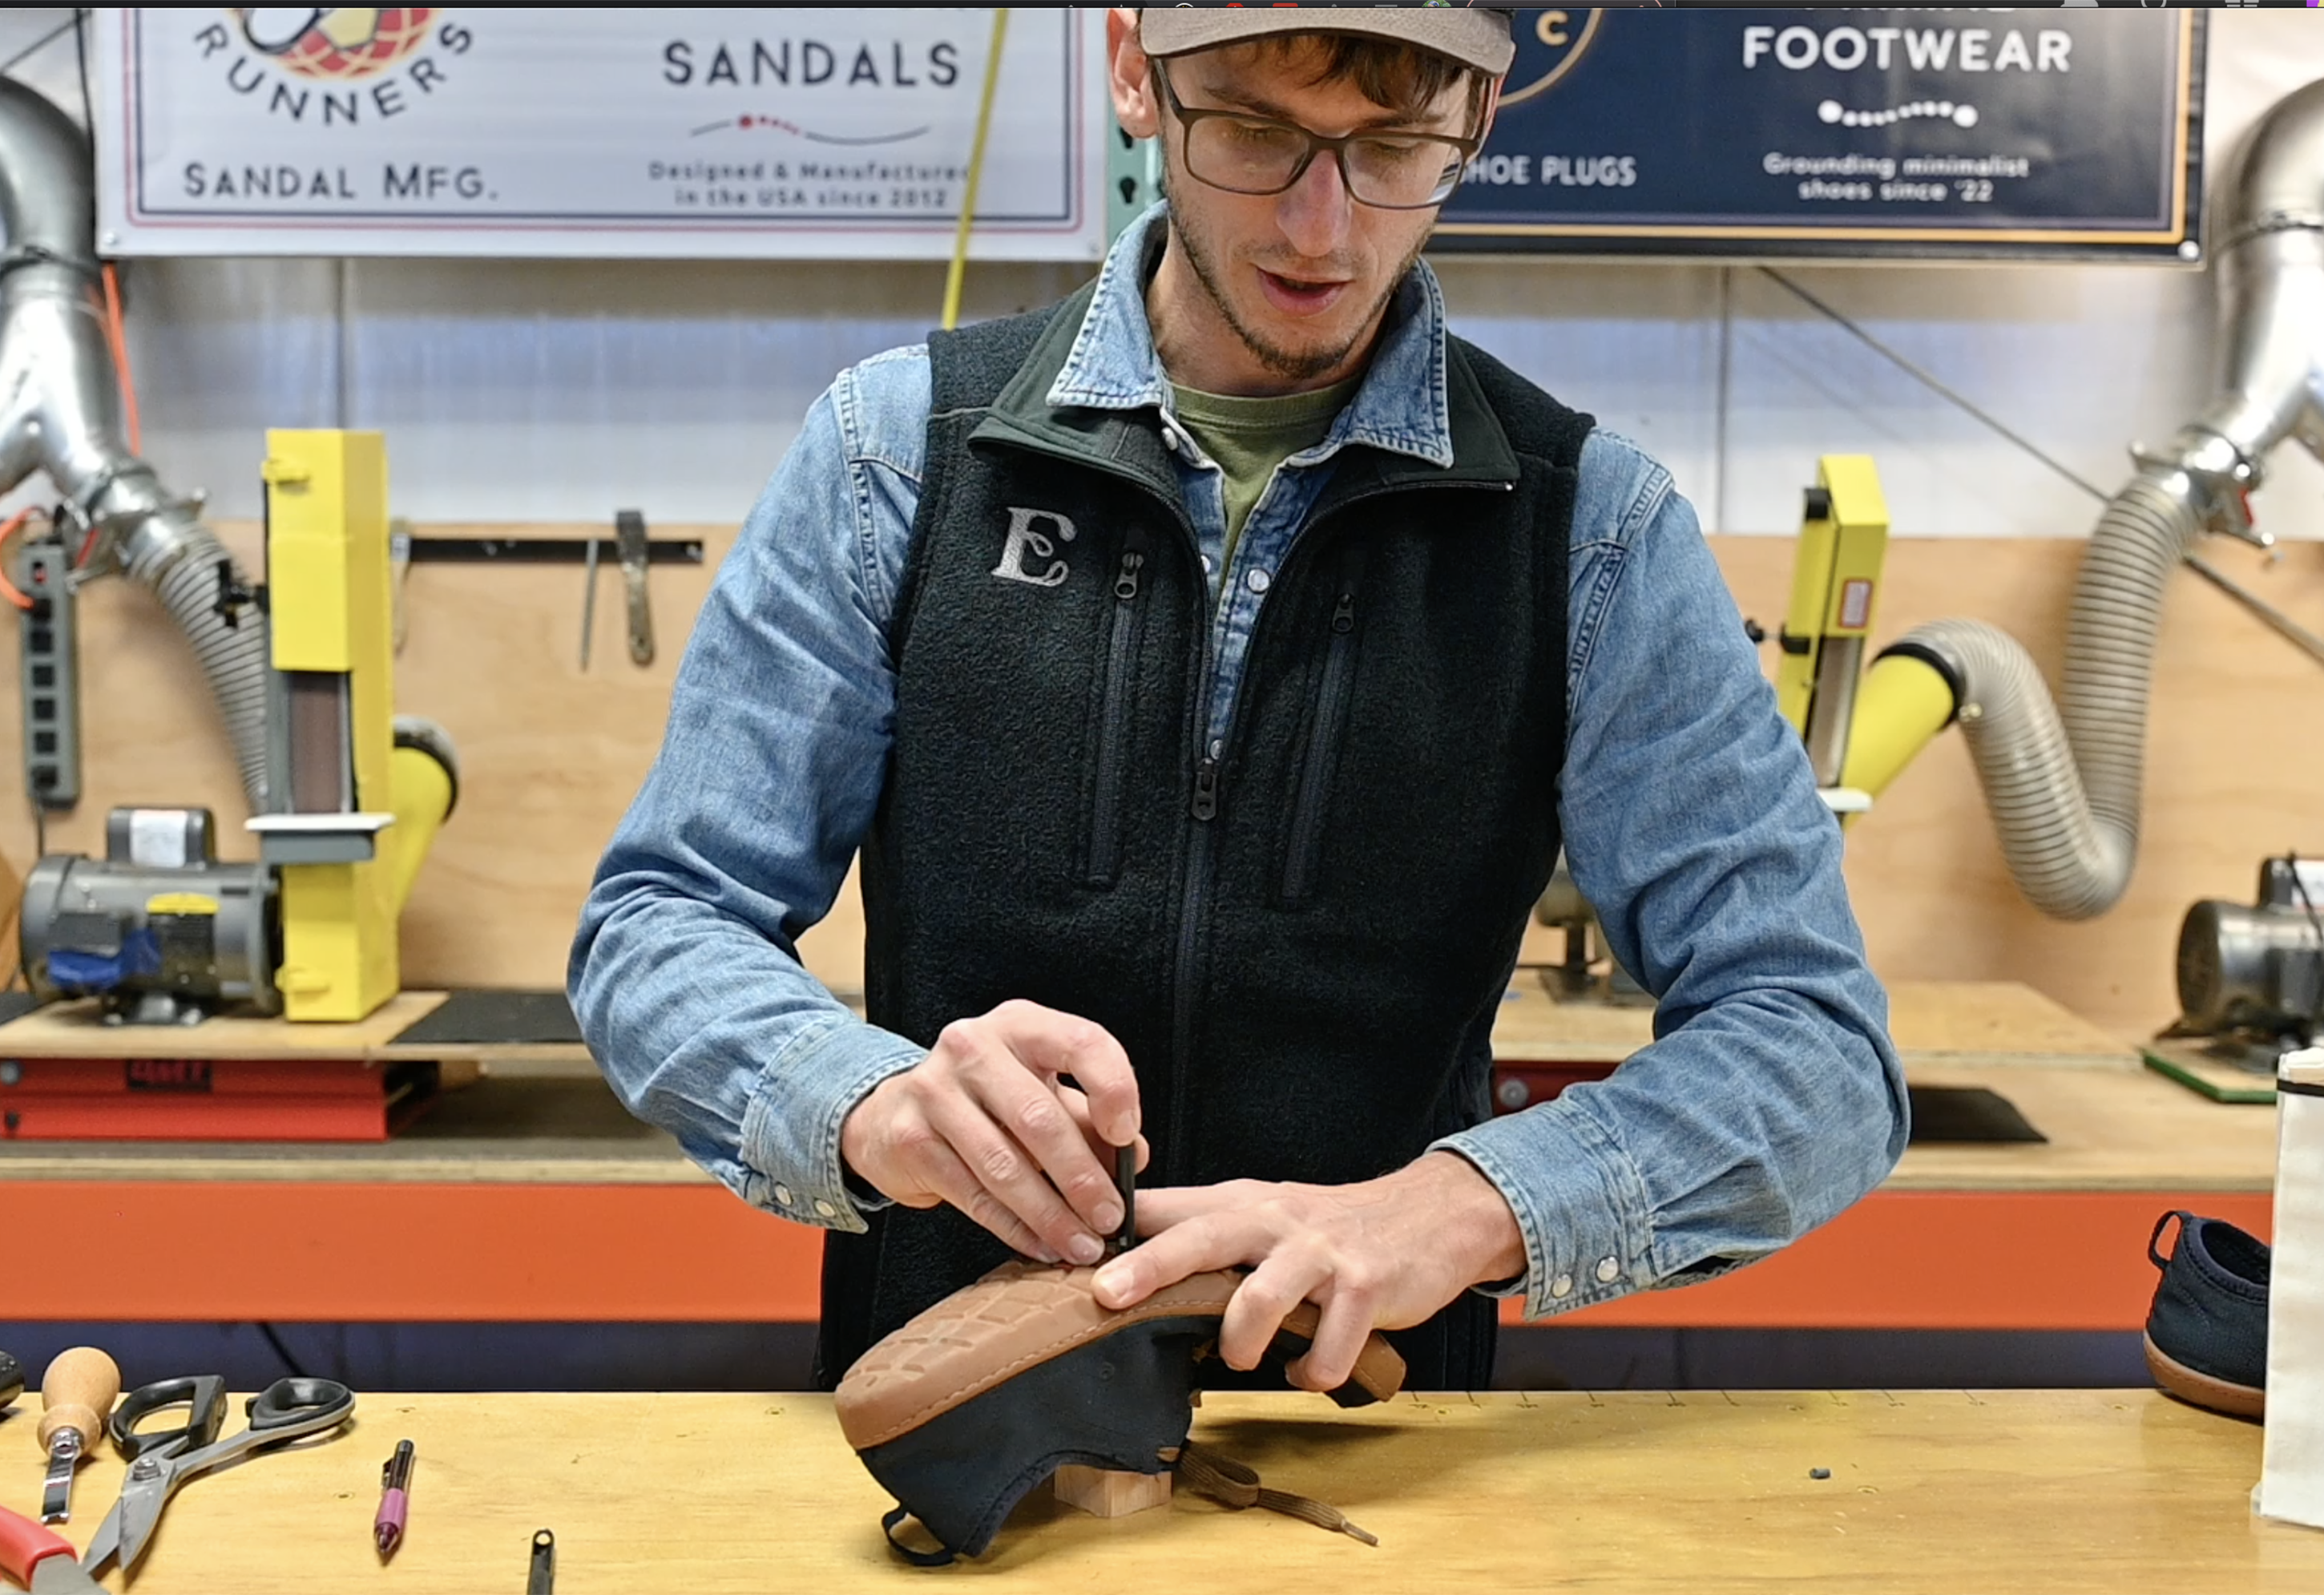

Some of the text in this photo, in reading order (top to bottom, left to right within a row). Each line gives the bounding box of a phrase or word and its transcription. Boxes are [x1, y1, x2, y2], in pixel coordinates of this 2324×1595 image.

[663, 41, 960, 87] SANDALS
[1742, 26, 2072, 72] FOOTWEAR
[195, 23, 473, 126] RUNNERS
[184, 162, 499, 200] SANDAL MFG.
[649, 161, 765, 184] Designed
[1460, 155, 1637, 186] HOE PLUGS
[1763, 152, 2029, 180] Grounding minimalist
[675, 186, 948, 208] in the USA since 2012
[1797, 178, 1874, 200] shoes
[1880, 178, 1948, 201] since
